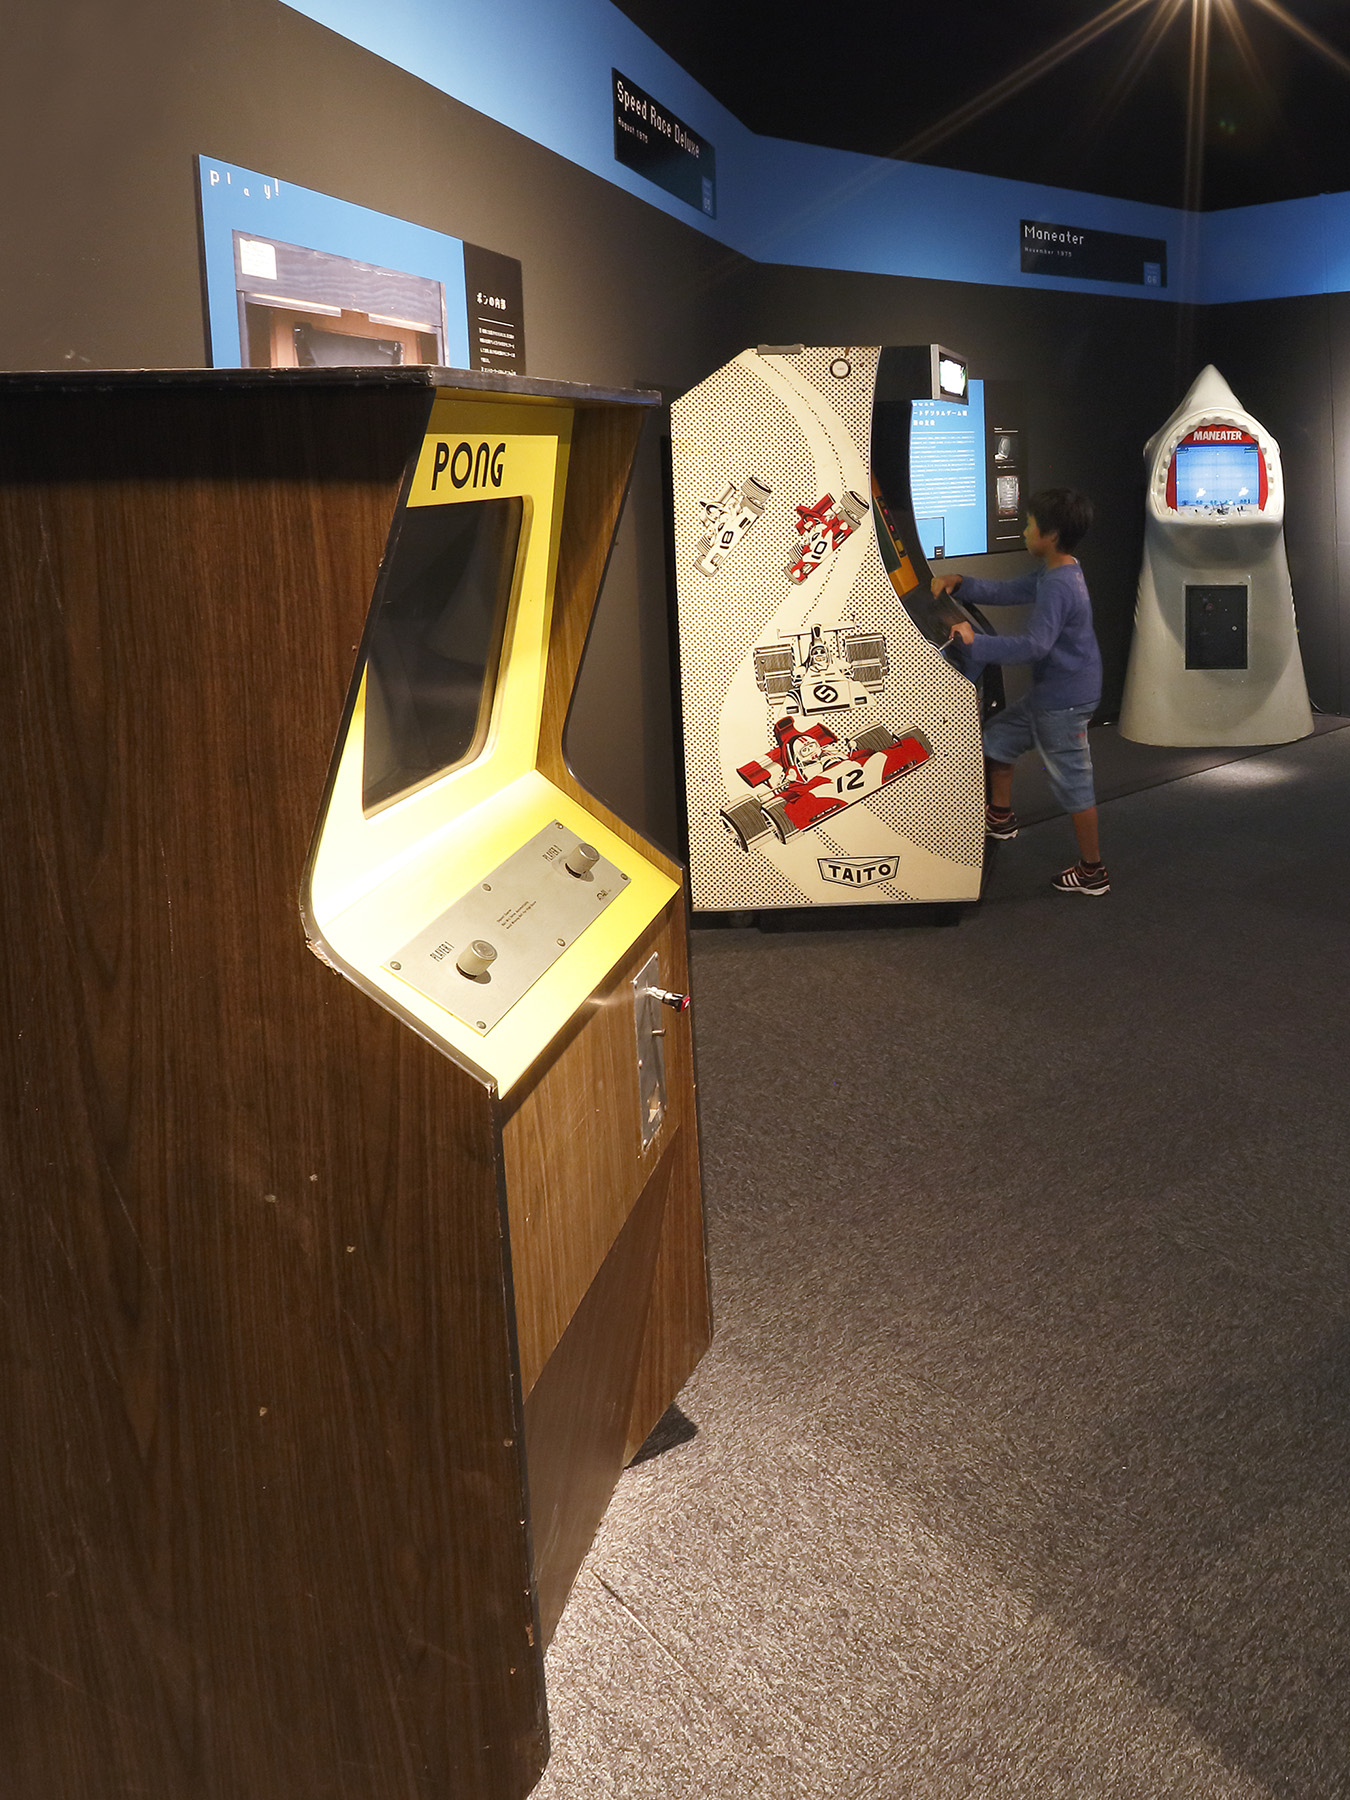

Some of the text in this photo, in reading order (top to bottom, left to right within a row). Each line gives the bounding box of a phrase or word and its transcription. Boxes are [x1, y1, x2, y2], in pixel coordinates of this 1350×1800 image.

[617, 80, 700, 159] Speed Race Deluxe
[1024, 225, 1085, 245] Maneater
[1193, 430, 1242, 441] MANEATER
[431, 441, 506, 491] PONG
[836, 768, 865, 793] 12
[828, 863, 892, 884] TAITO
[430, 943, 453, 962] PLAYER
